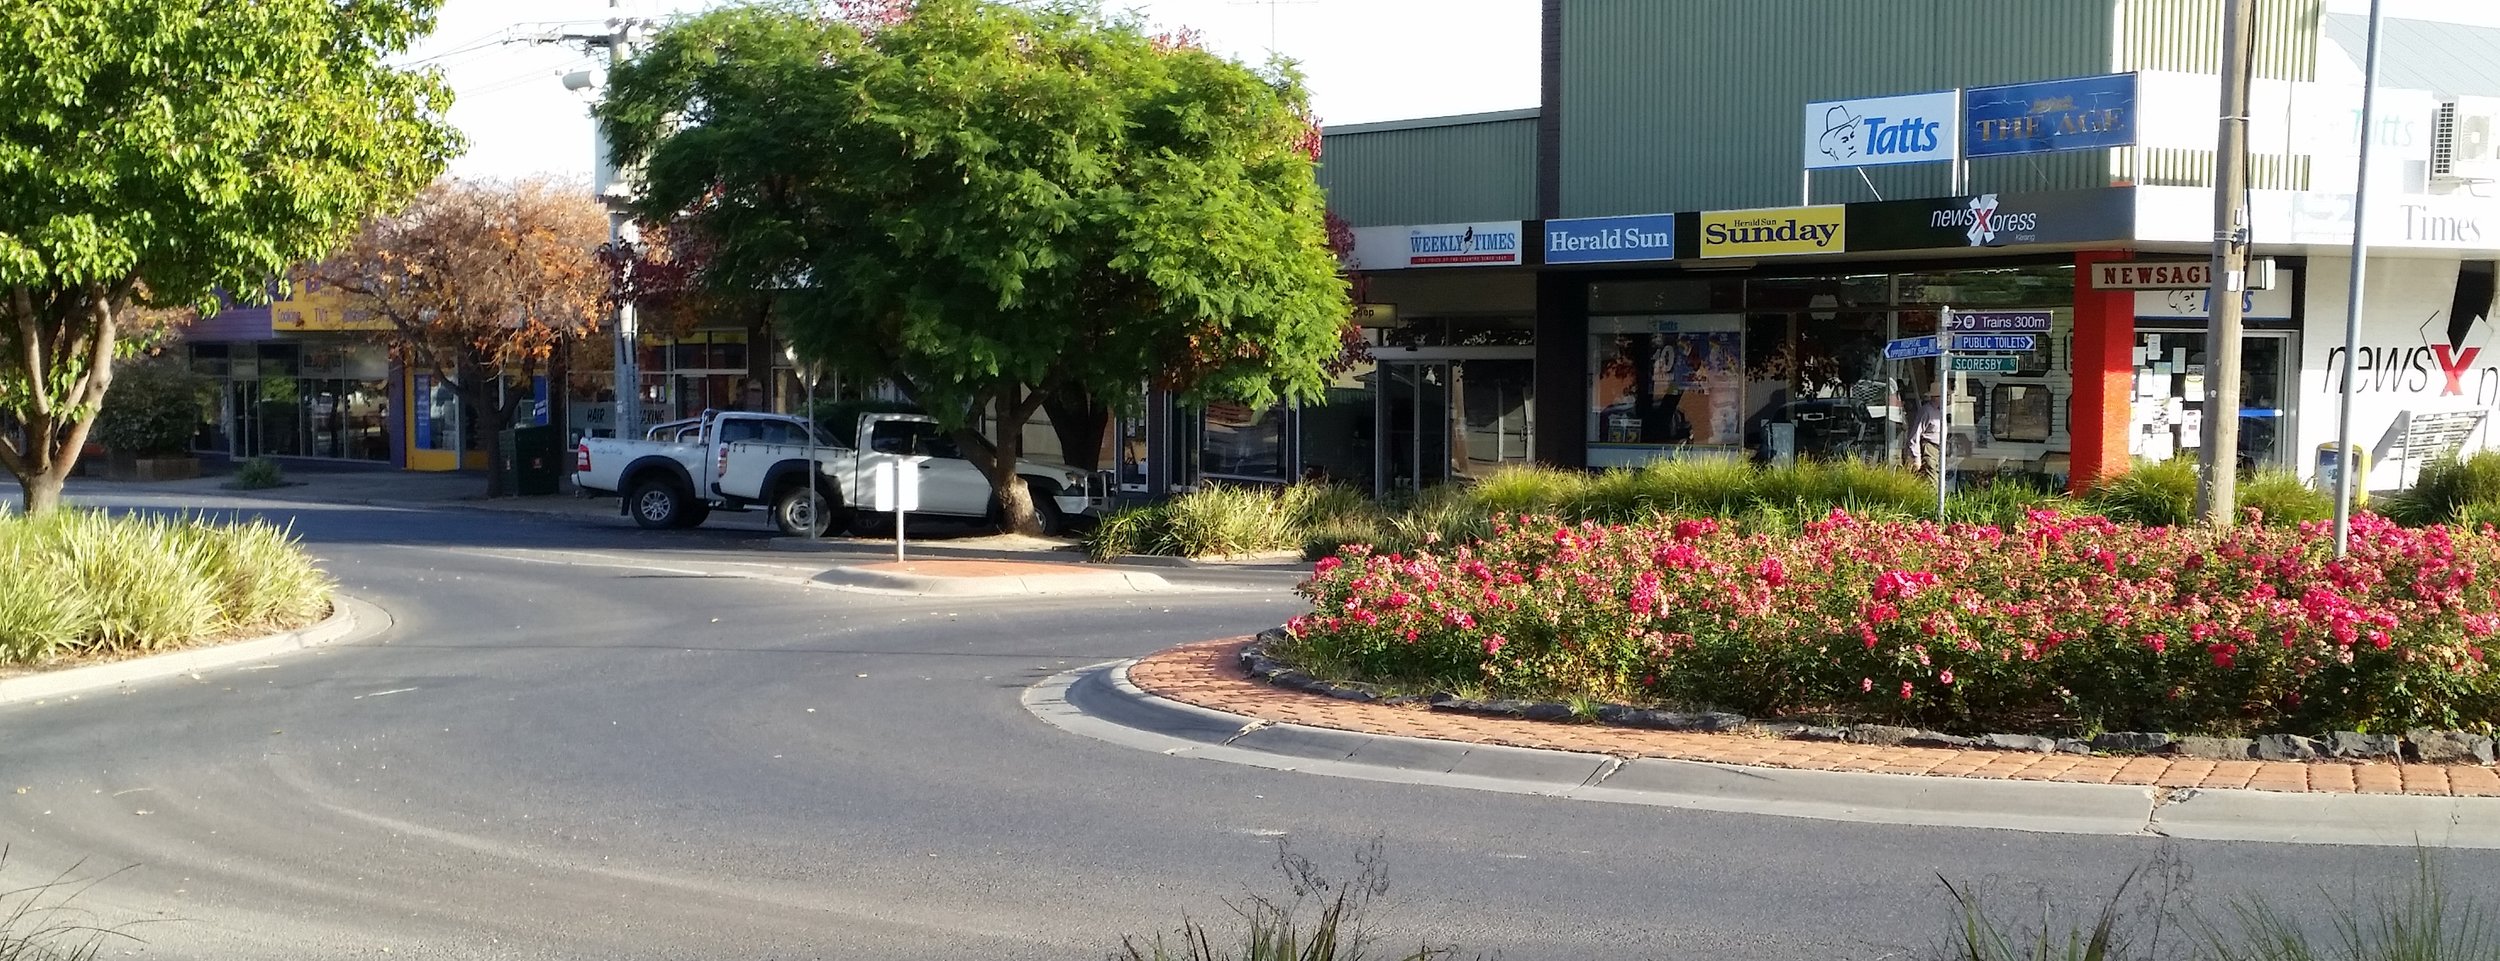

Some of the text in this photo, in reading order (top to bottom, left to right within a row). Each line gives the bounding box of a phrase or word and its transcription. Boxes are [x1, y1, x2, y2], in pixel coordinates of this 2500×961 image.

[1864, 115, 1940, 155] Tatts
[1975, 115, 2045, 142] THE
[1733, 218, 1778, 228] Herald Sun
[1931, 206, 2037, 234] newsXpress
[2400, 204, 2481, 242] Times
[1410, 232, 1516, 253] WEEKLY TIMES
[1550, 228, 1669, 252] Herald Sun
[1706, 220, 1840, 247] Sunday
[1982, 316, 2045, 328] Trains 300m
[1963, 336, 2026, 349] PUBLIC TOILETS
[1955, 358, 2003, 370] SCORESBY
[587, 408, 605, 423] HAIR
